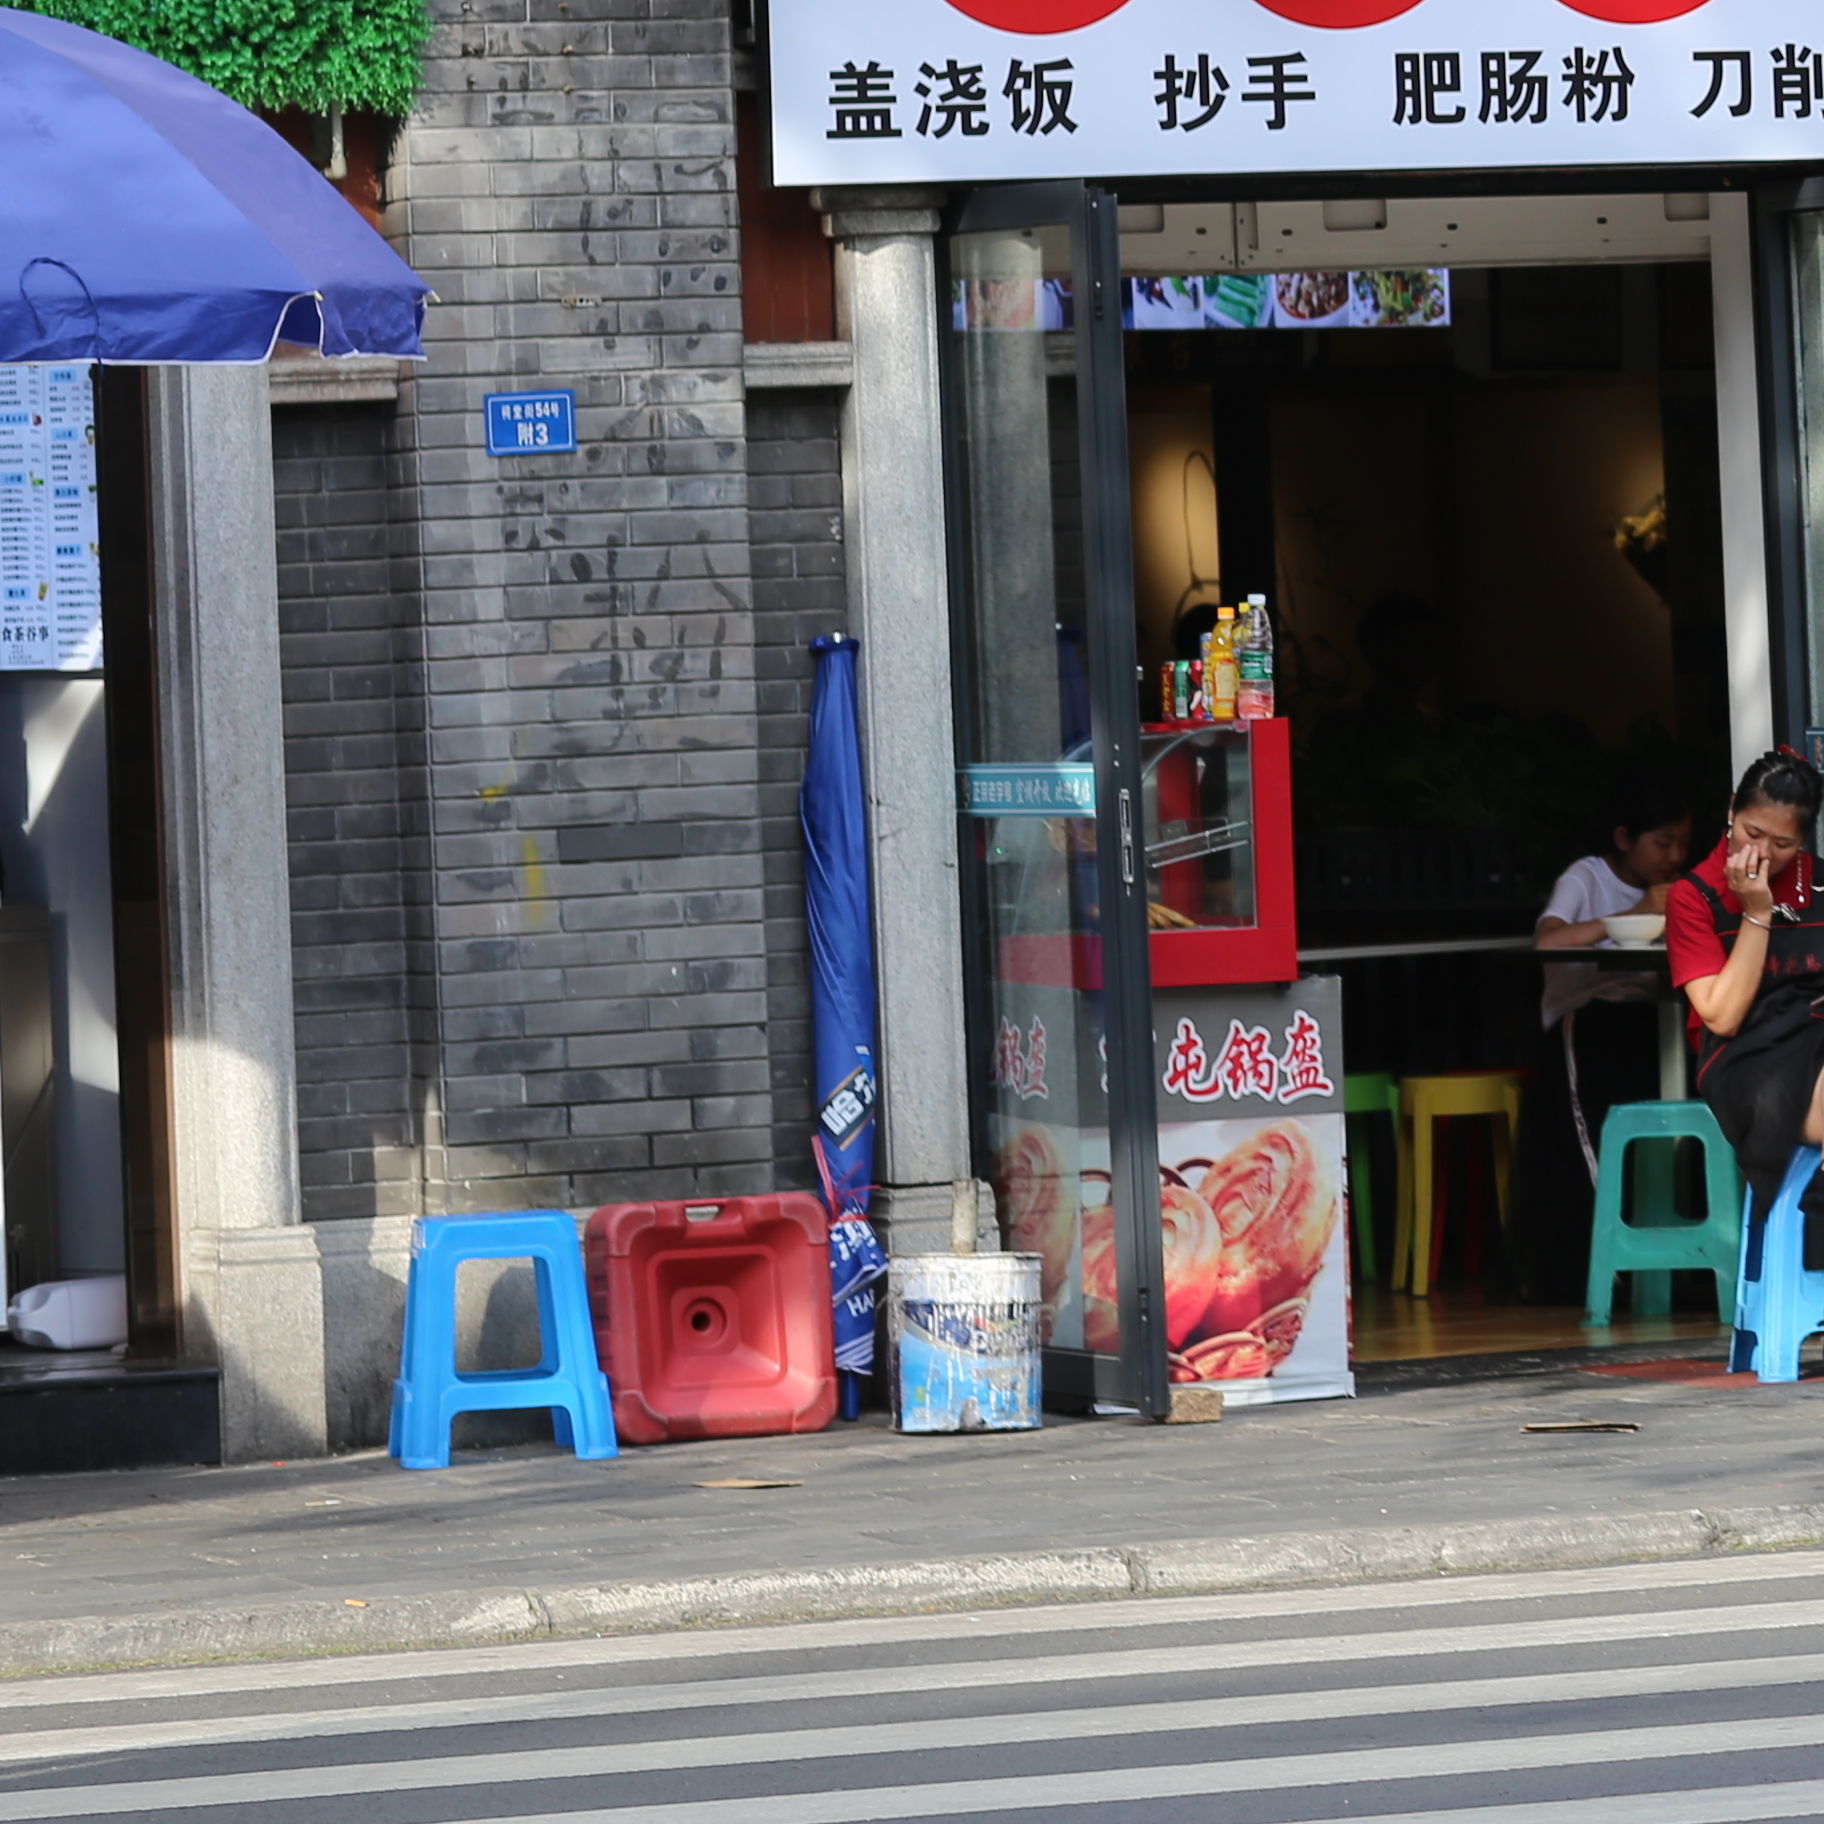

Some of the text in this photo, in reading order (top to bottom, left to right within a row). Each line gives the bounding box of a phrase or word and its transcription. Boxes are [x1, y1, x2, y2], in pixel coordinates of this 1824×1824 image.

[826, 58, 1079, 141] 盖浇饭
[1153, 52, 1317, 132] 抄手
[1392, 46, 1635, 127] 肥肠粉
[1158, 1008, 1336, 1106] 屯锅盔
